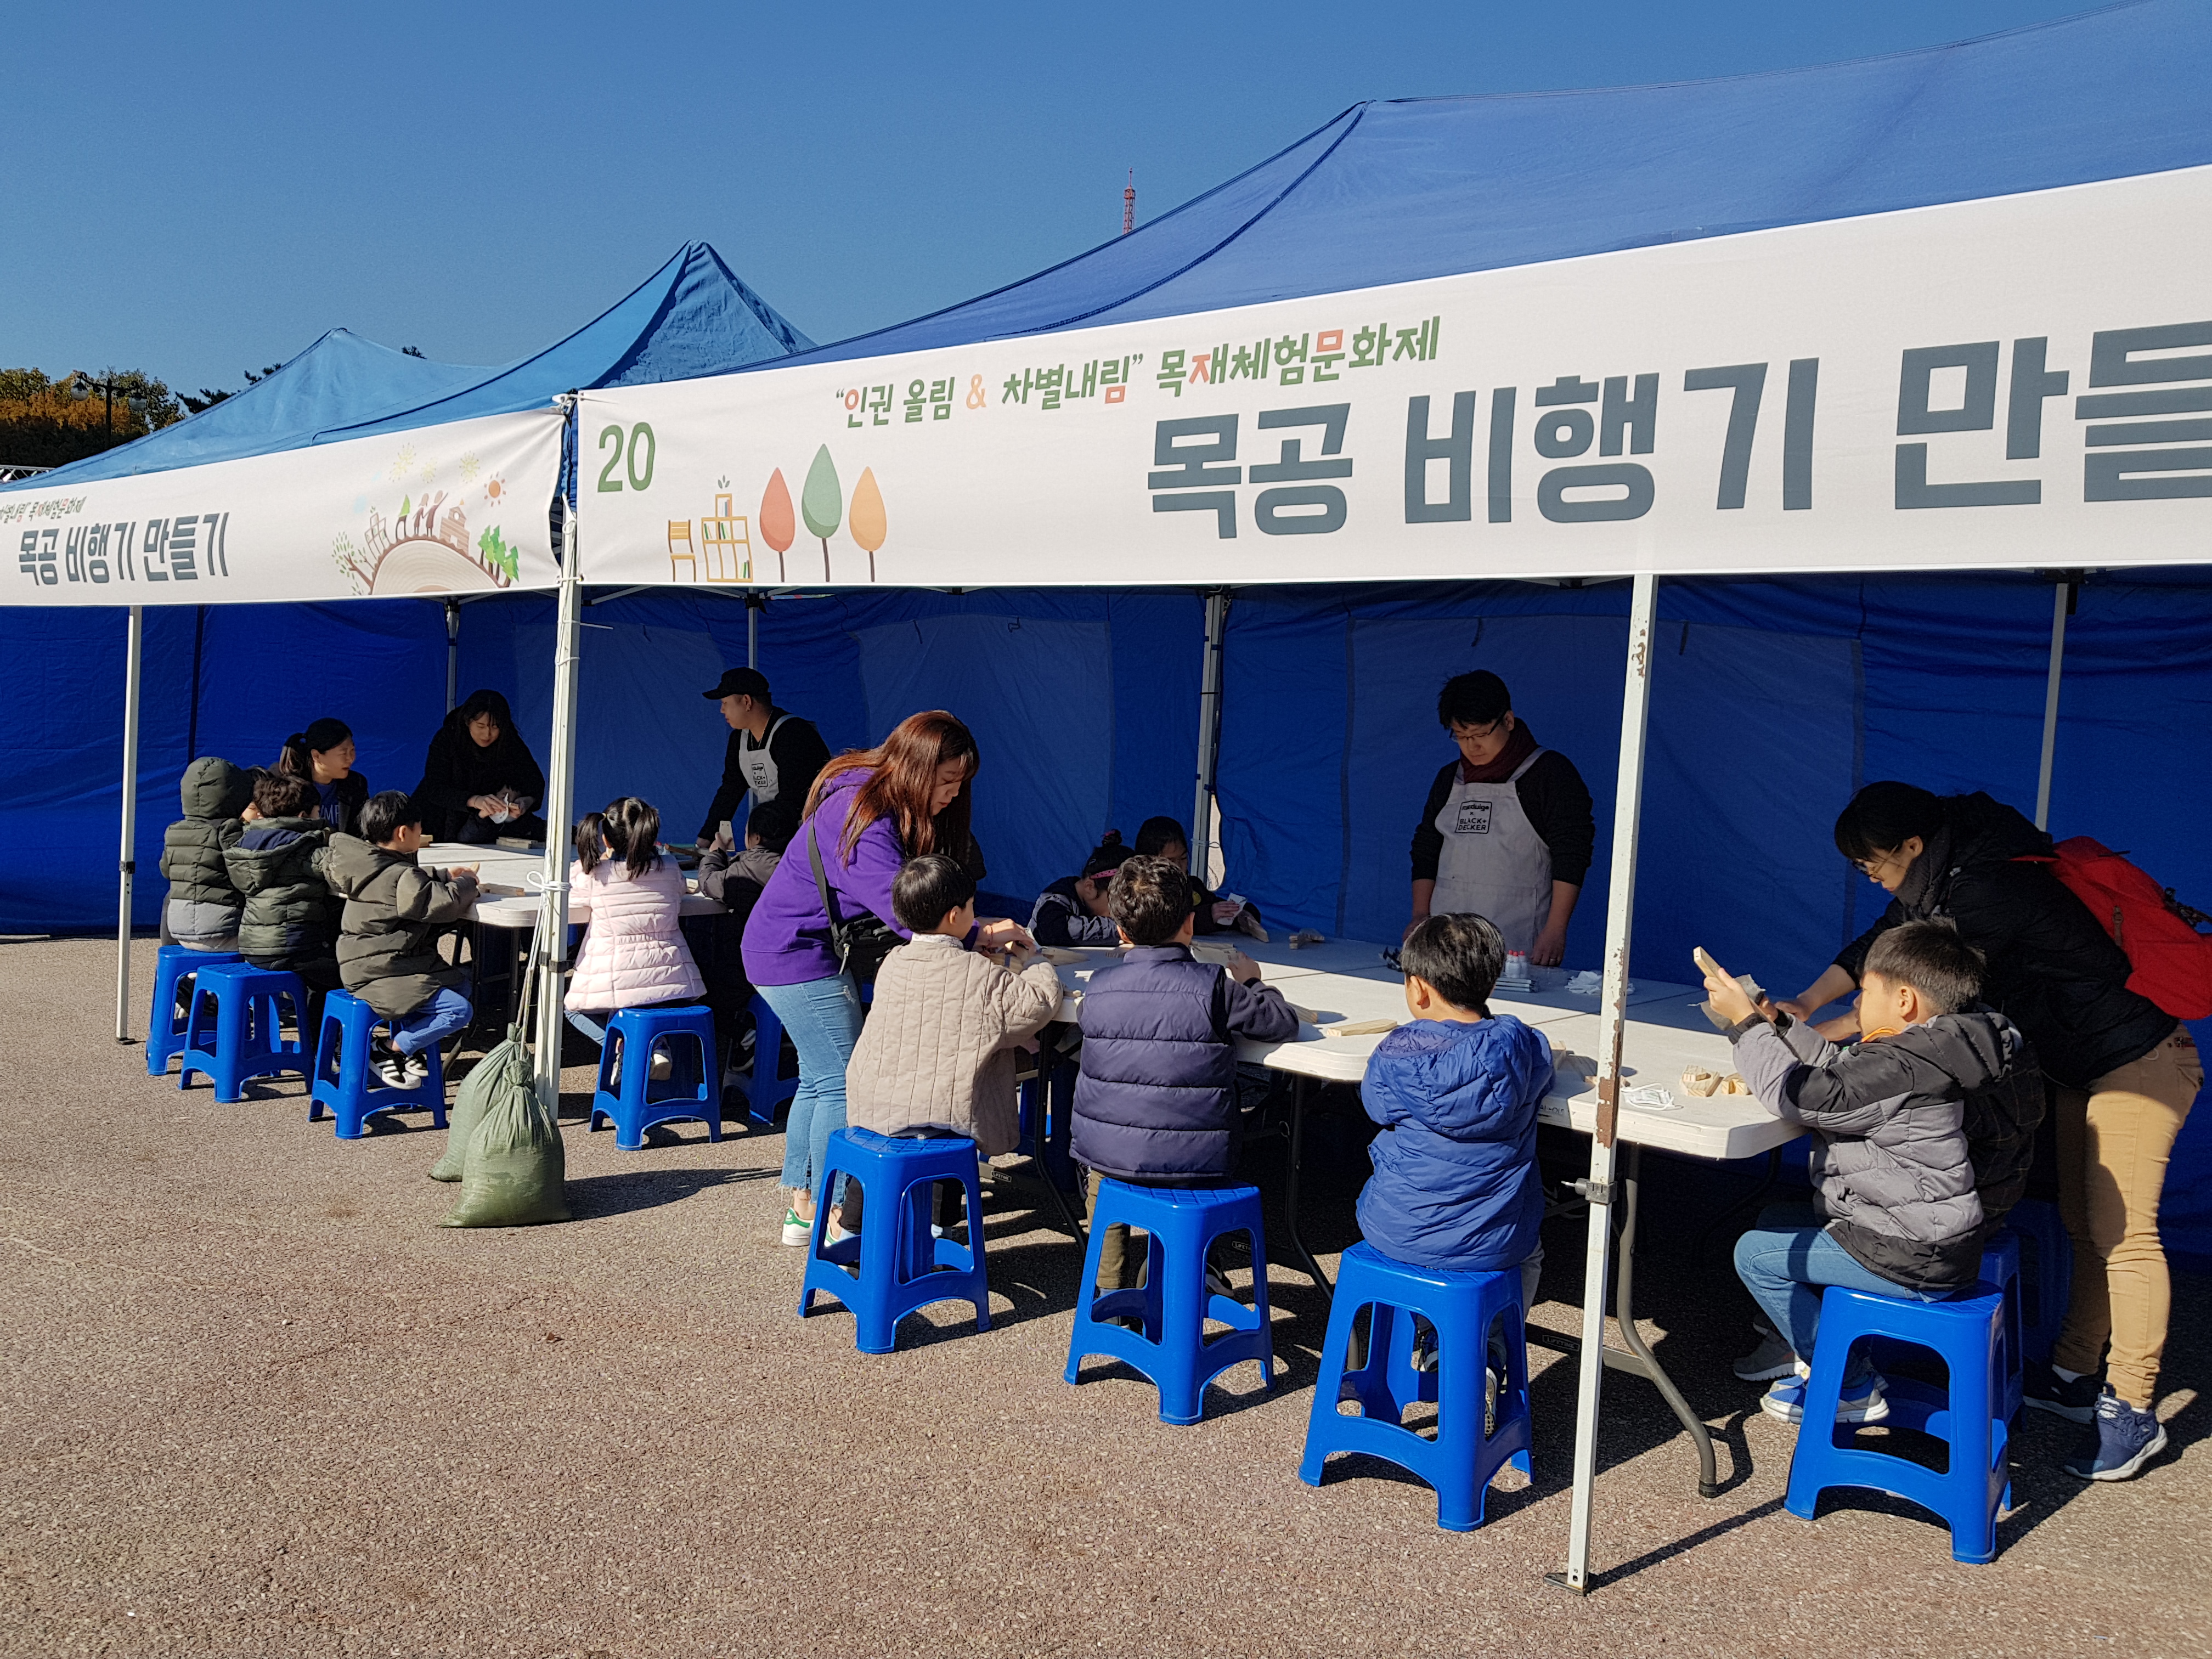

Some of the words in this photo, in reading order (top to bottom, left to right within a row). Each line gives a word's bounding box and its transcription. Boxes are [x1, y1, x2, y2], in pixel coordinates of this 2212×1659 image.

[904, 376, 955, 422] 올림
[966, 374, 986, 409] &
[1156, 315, 1440, 397] 목재체험문화제
[597, 421, 656, 493] 20
[1148, 403, 1353, 539] 목공
[1405, 357, 1819, 523] 비행기
[19, 528, 59, 586] 목공
[66, 522, 136, 583] 비행기
[144, 512, 229, 582] 만들기
